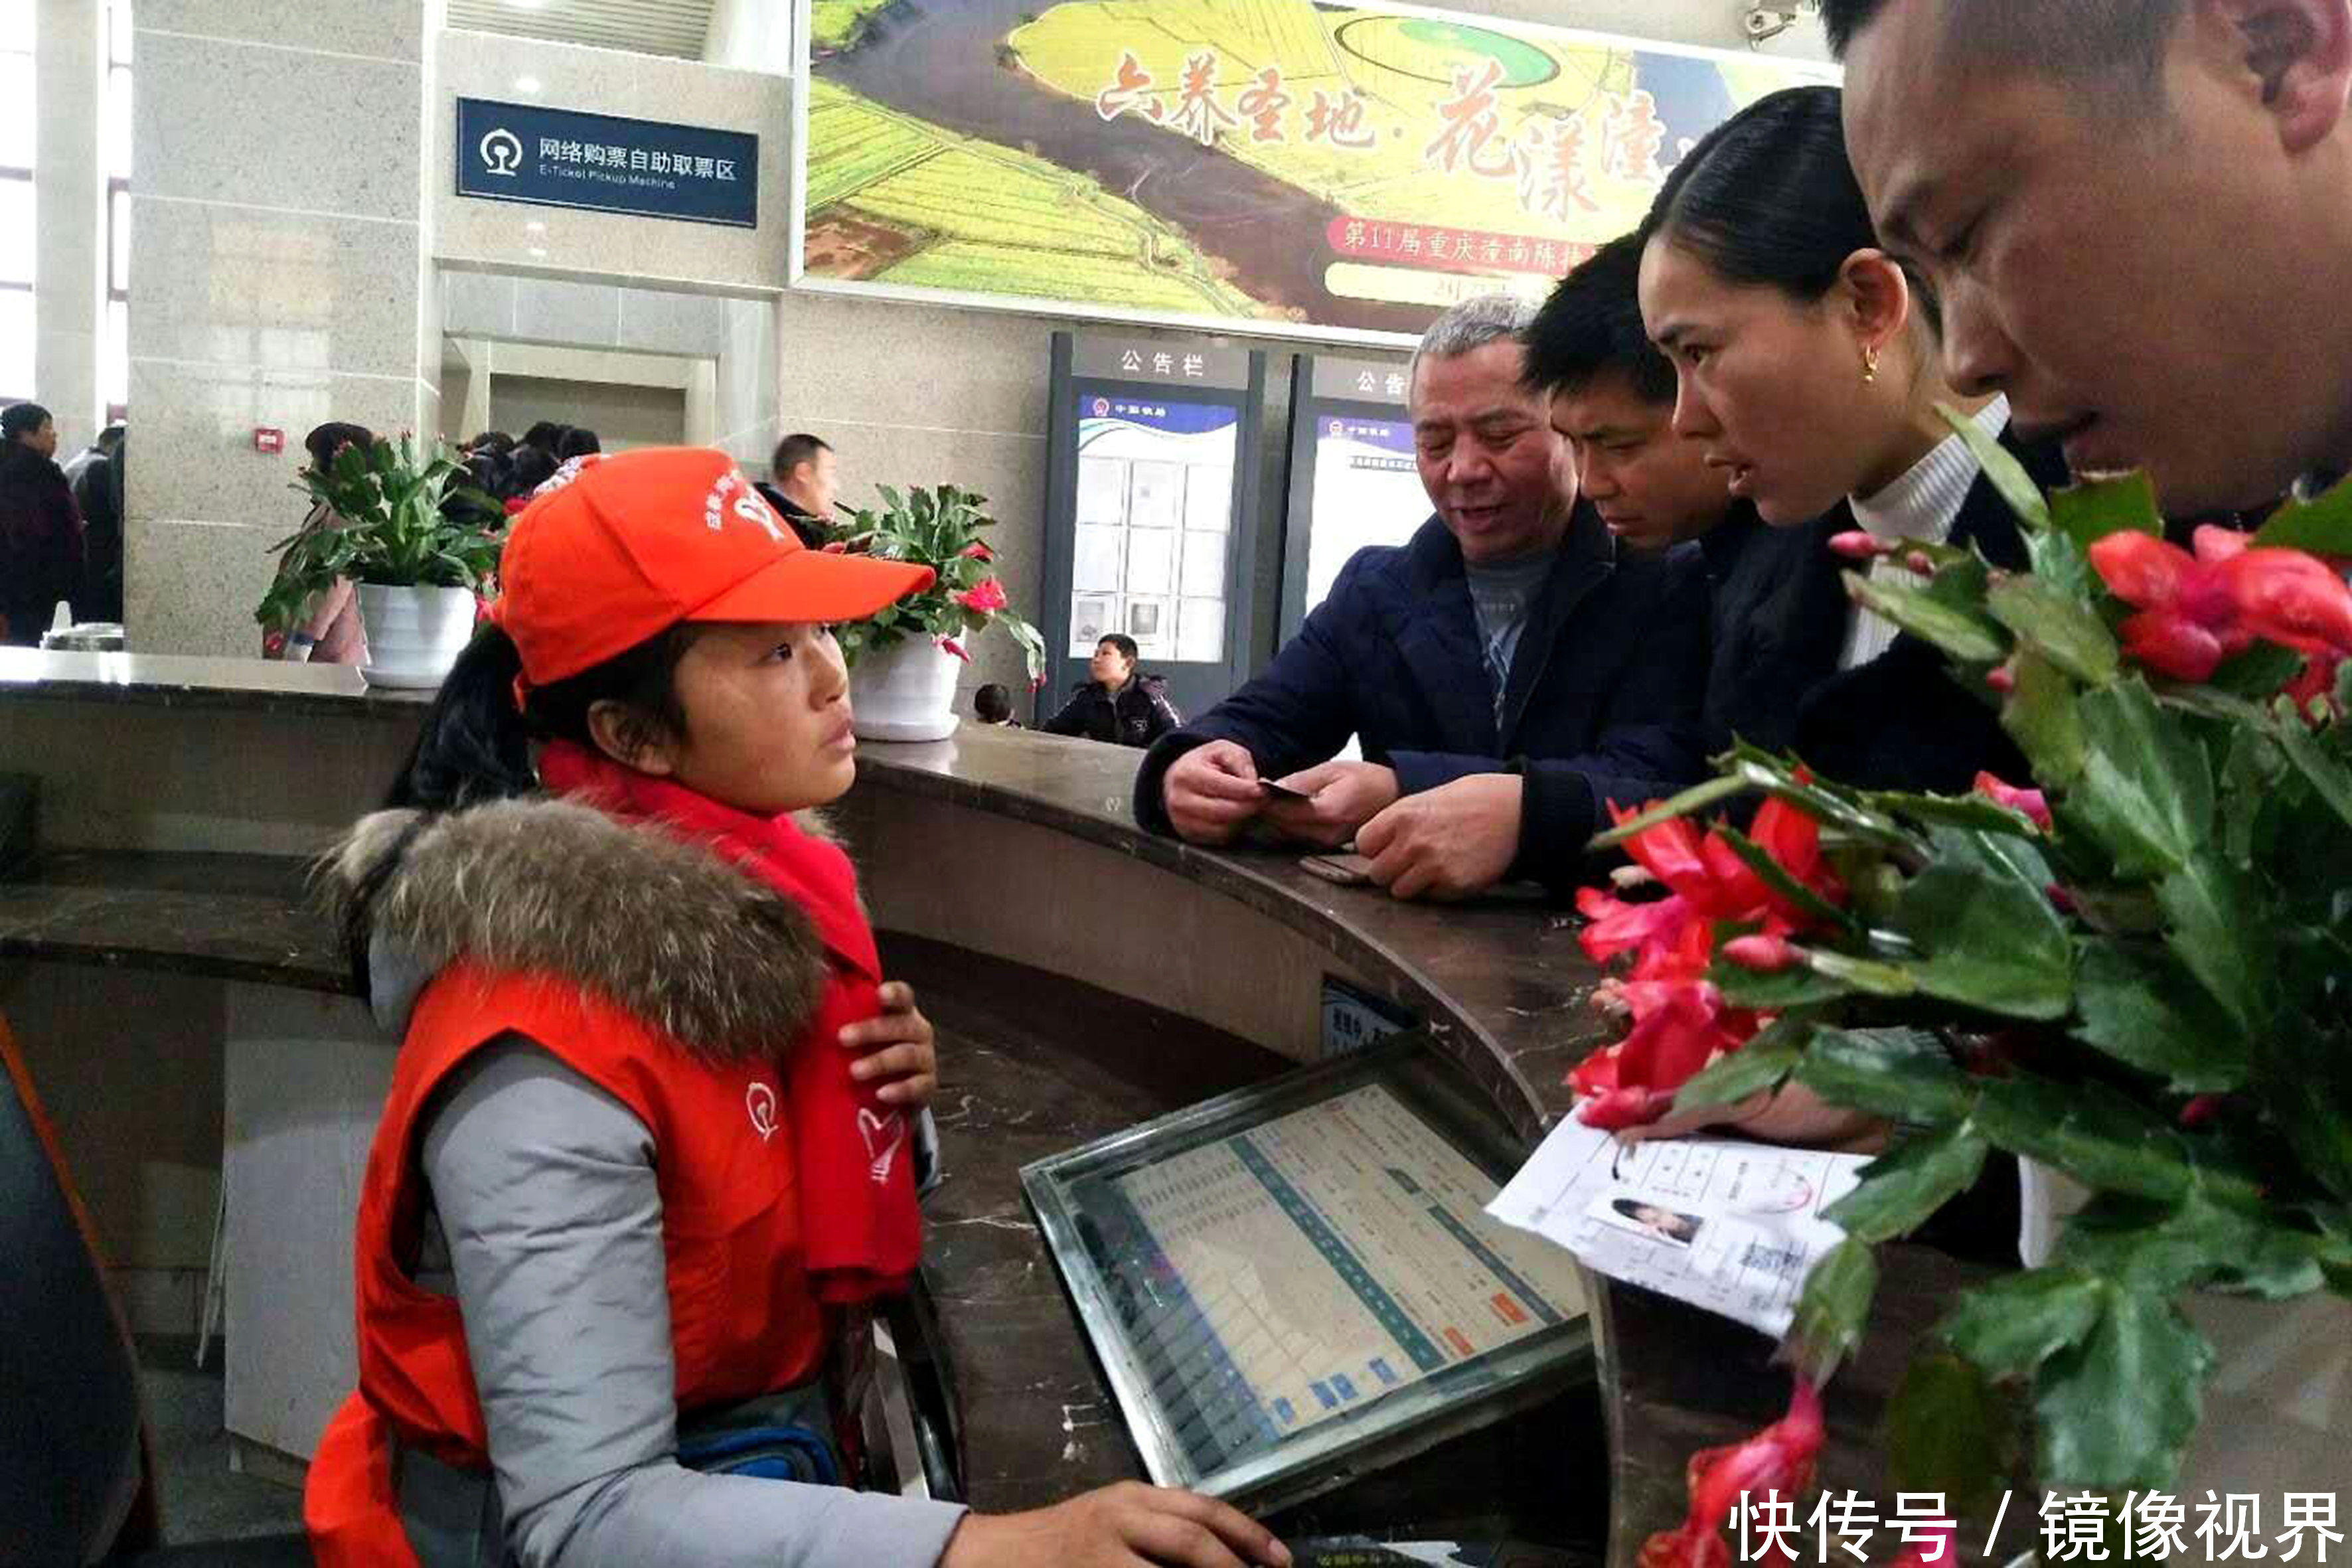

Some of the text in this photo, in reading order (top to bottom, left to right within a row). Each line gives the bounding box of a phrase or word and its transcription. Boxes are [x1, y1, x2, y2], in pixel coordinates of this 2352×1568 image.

[539, 137, 736, 181] 网络购票自助取票区
[589, 171, 626, 184] Pickup
[629, 174, 675, 189] Machine
[1121, 349, 1203, 376] 公告栏
[1357, 370, 1405, 394] 公告
